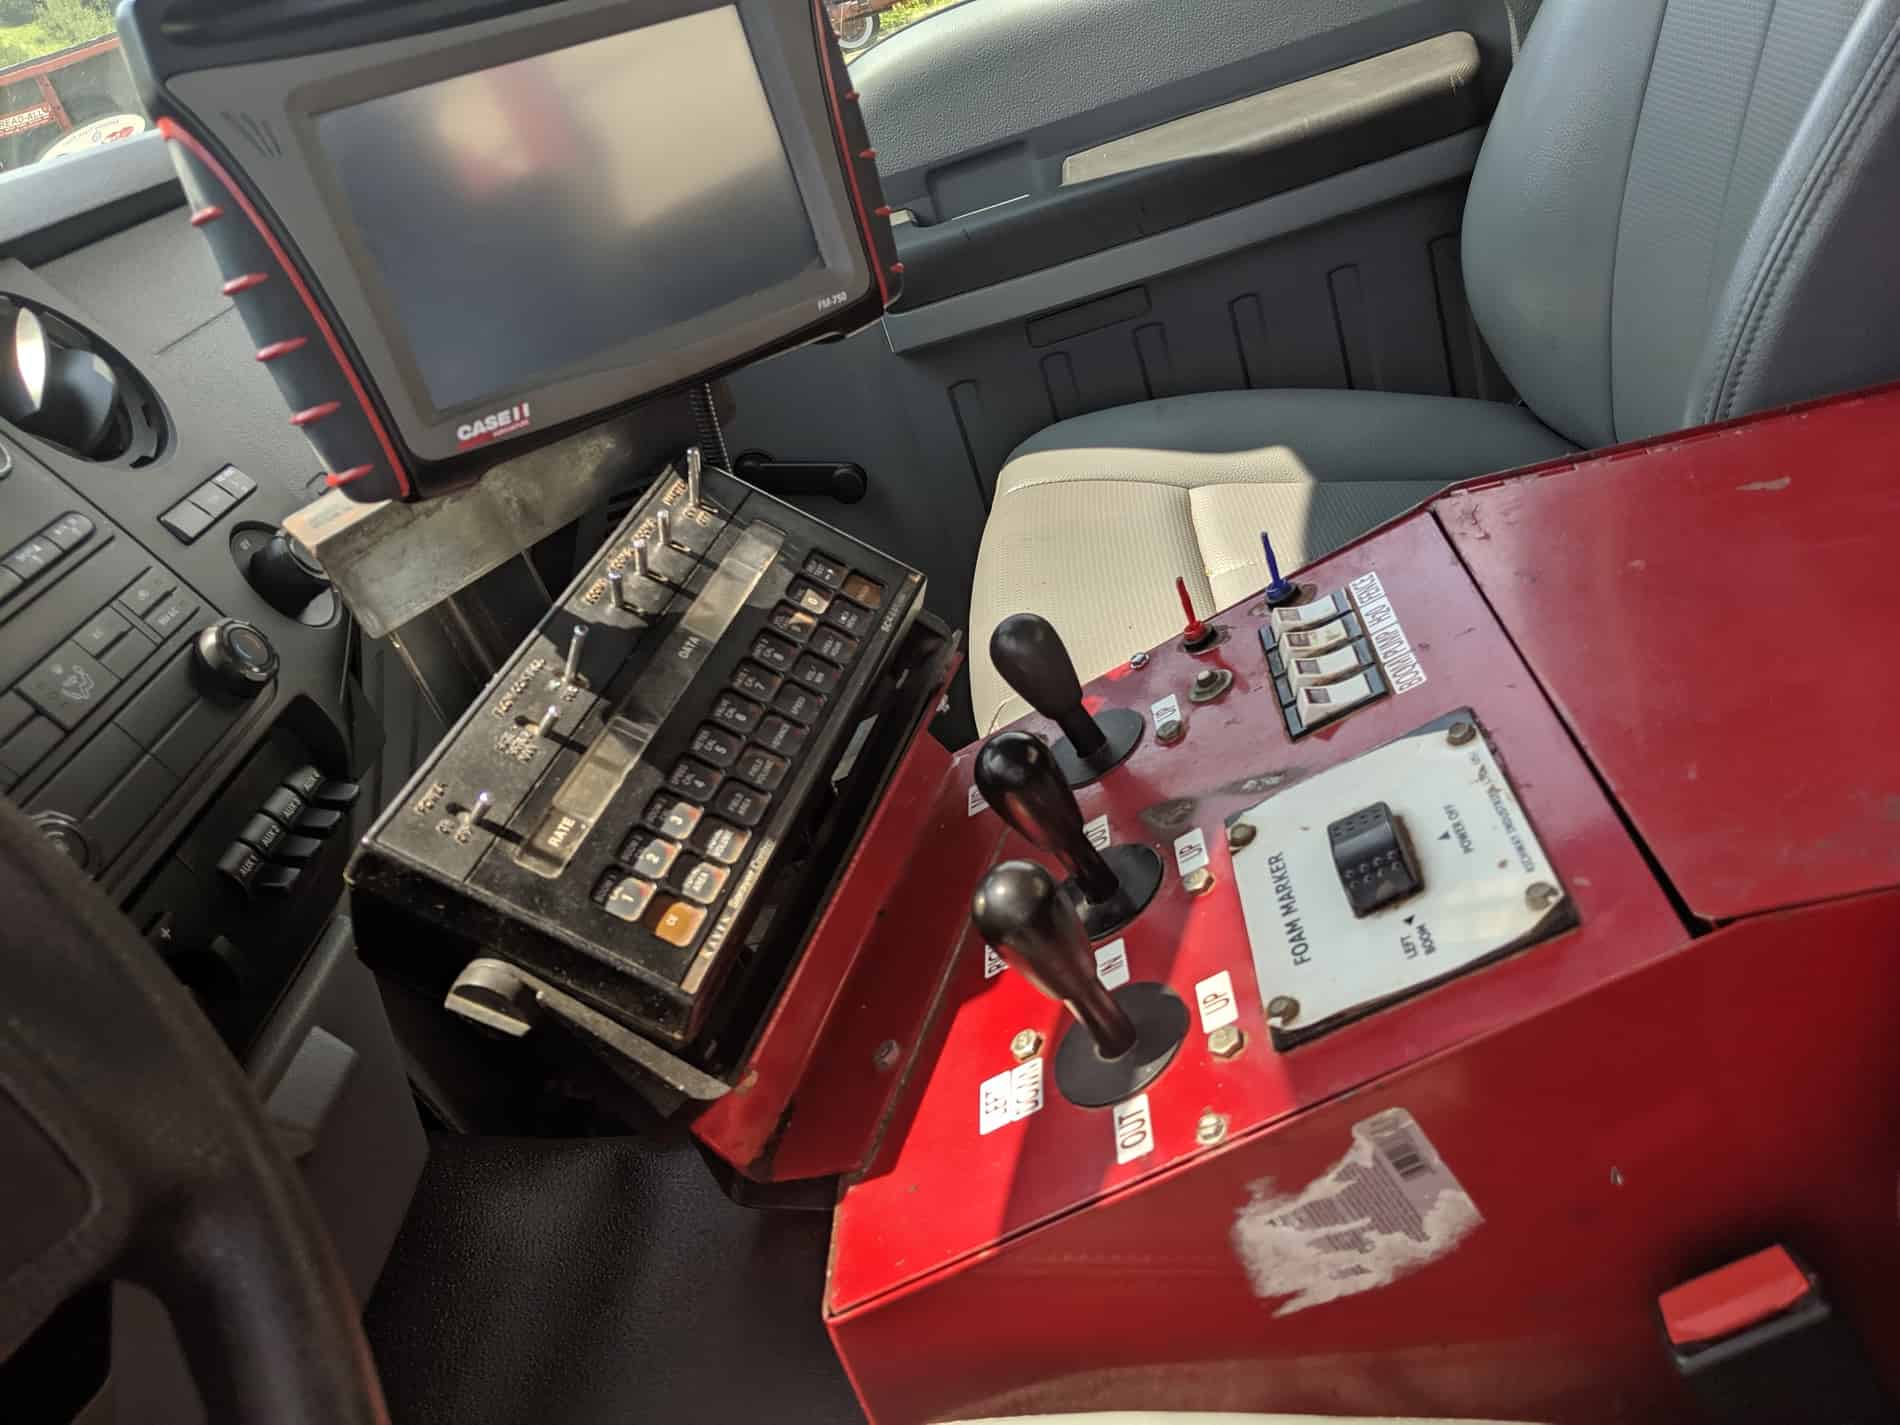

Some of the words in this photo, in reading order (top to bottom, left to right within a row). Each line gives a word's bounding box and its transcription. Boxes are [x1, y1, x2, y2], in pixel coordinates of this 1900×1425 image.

[457, 409, 512, 440] CASE
[677, 634, 699, 659] DATA
[714, 743, 727, 755] 5
[548, 815, 574, 847] RATE
[669, 813, 683, 826] 3
[1451, 820, 1475, 854] POWER
[645, 850, 660, 864] 2
[1179, 844, 1203, 864] UP
[1267, 851, 1299, 917] MARKER
[1284, 917, 1311, 966] FOAM
[1400, 935, 1418, 960] LEFT
[1416, 923, 1436, 955] BOOM
[1202, 991, 1230, 1016] UP
[1118, 1108, 1147, 1150] OUT
